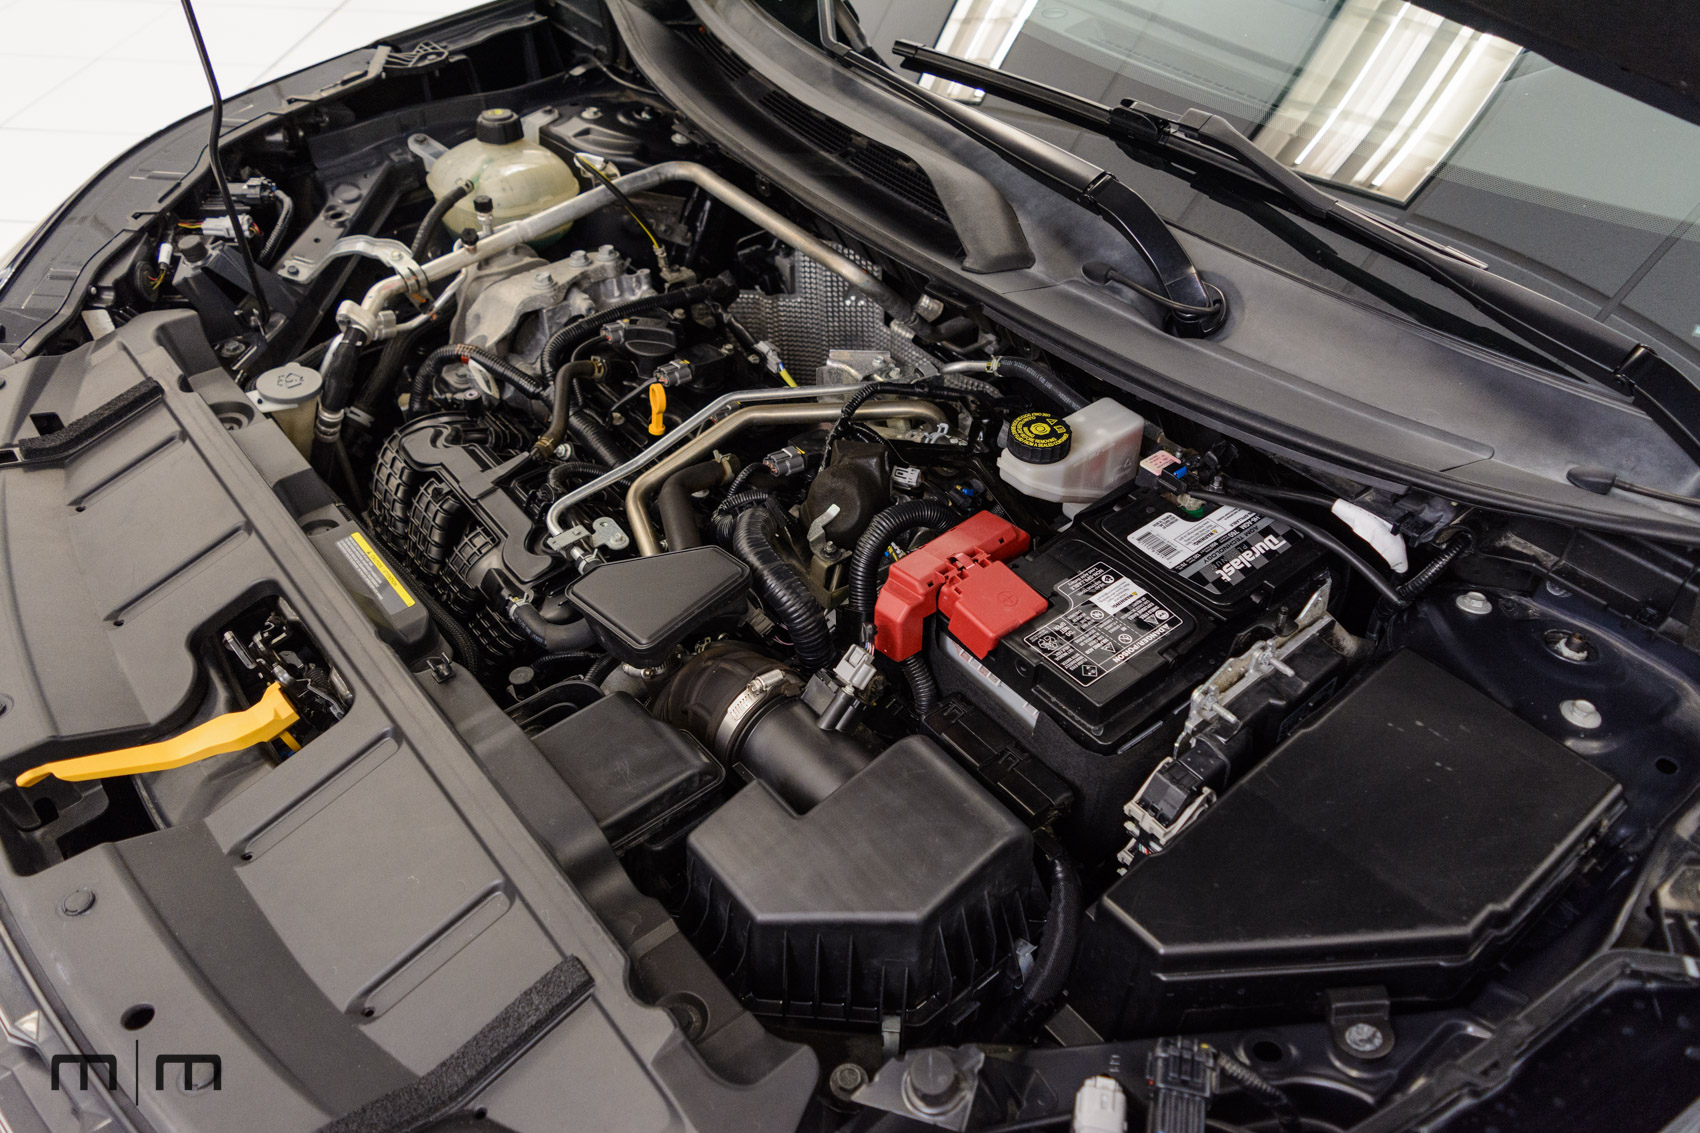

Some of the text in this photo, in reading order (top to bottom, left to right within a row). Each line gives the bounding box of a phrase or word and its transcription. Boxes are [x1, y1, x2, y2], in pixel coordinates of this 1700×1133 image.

[1191, 531, 1214, 546] WARNING:
[1243, 525, 1260, 536] AGM
[1201, 535, 1244, 564] TECHNOLOGY
[1215, 534, 1287, 582] Duralast
[1111, 626, 1165, 663] DANGER/POISON
